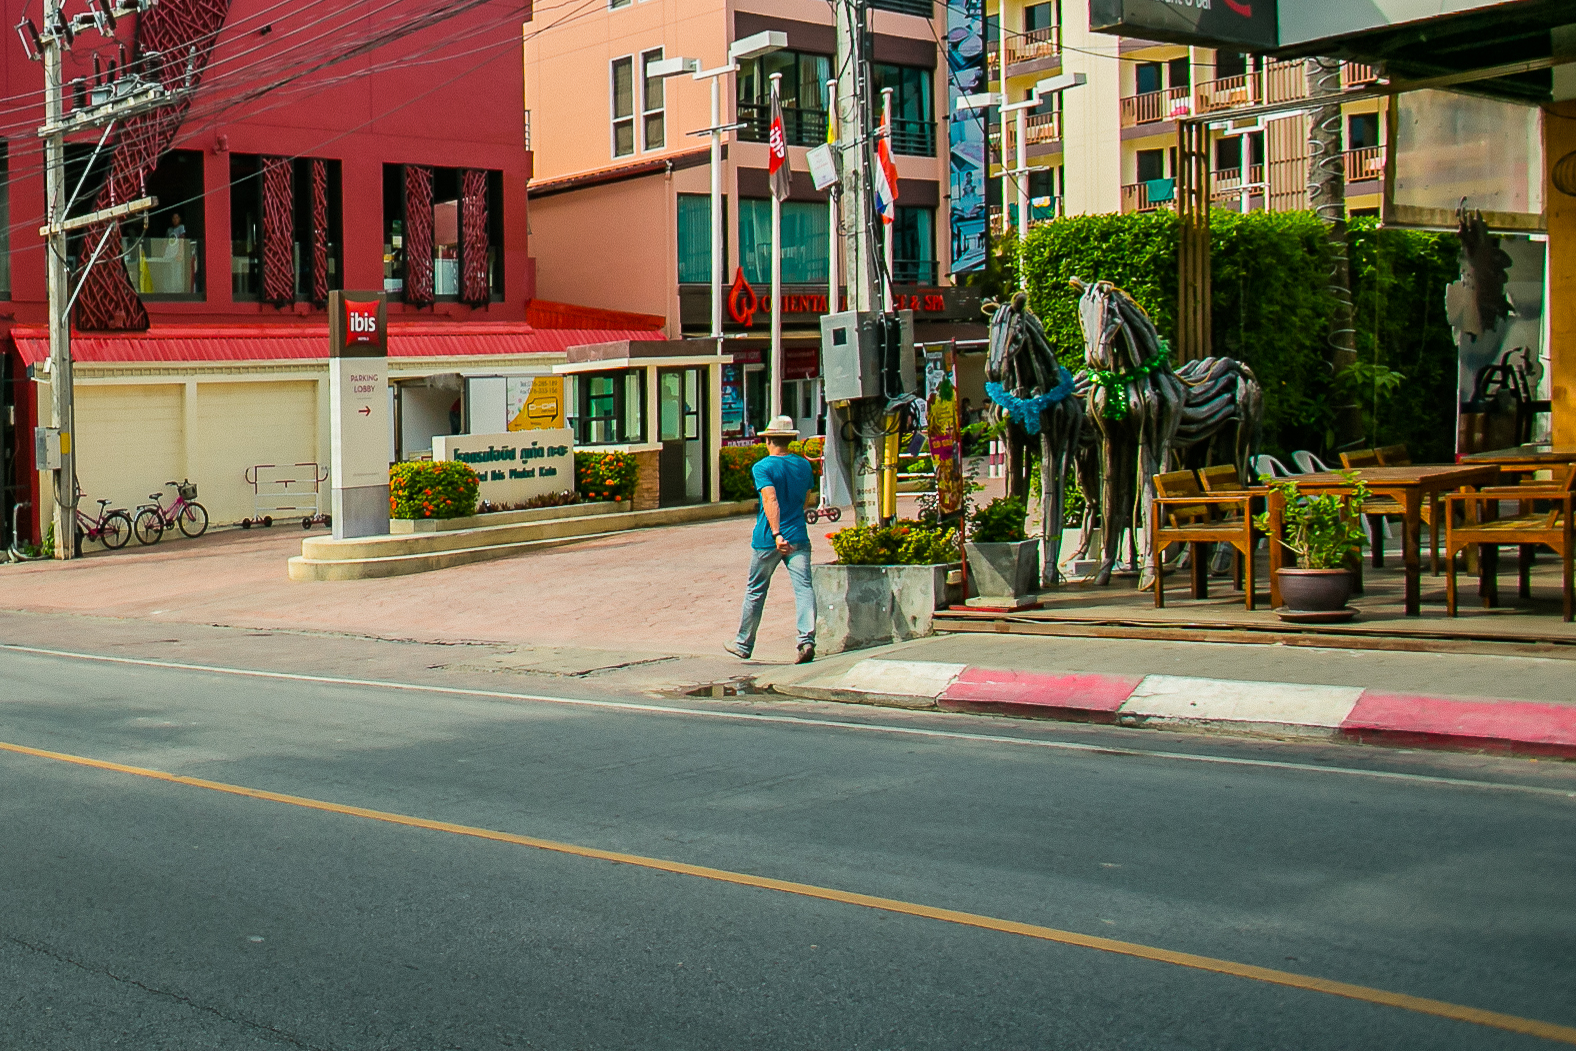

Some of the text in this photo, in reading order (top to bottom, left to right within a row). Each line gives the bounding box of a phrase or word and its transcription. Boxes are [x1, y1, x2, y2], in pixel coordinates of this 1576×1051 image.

[924, 294, 945, 311] SPA
[350, 311, 376, 332] ibis
[350, 373, 379, 382] PARKING
[353, 385, 376, 393] LOBBY
